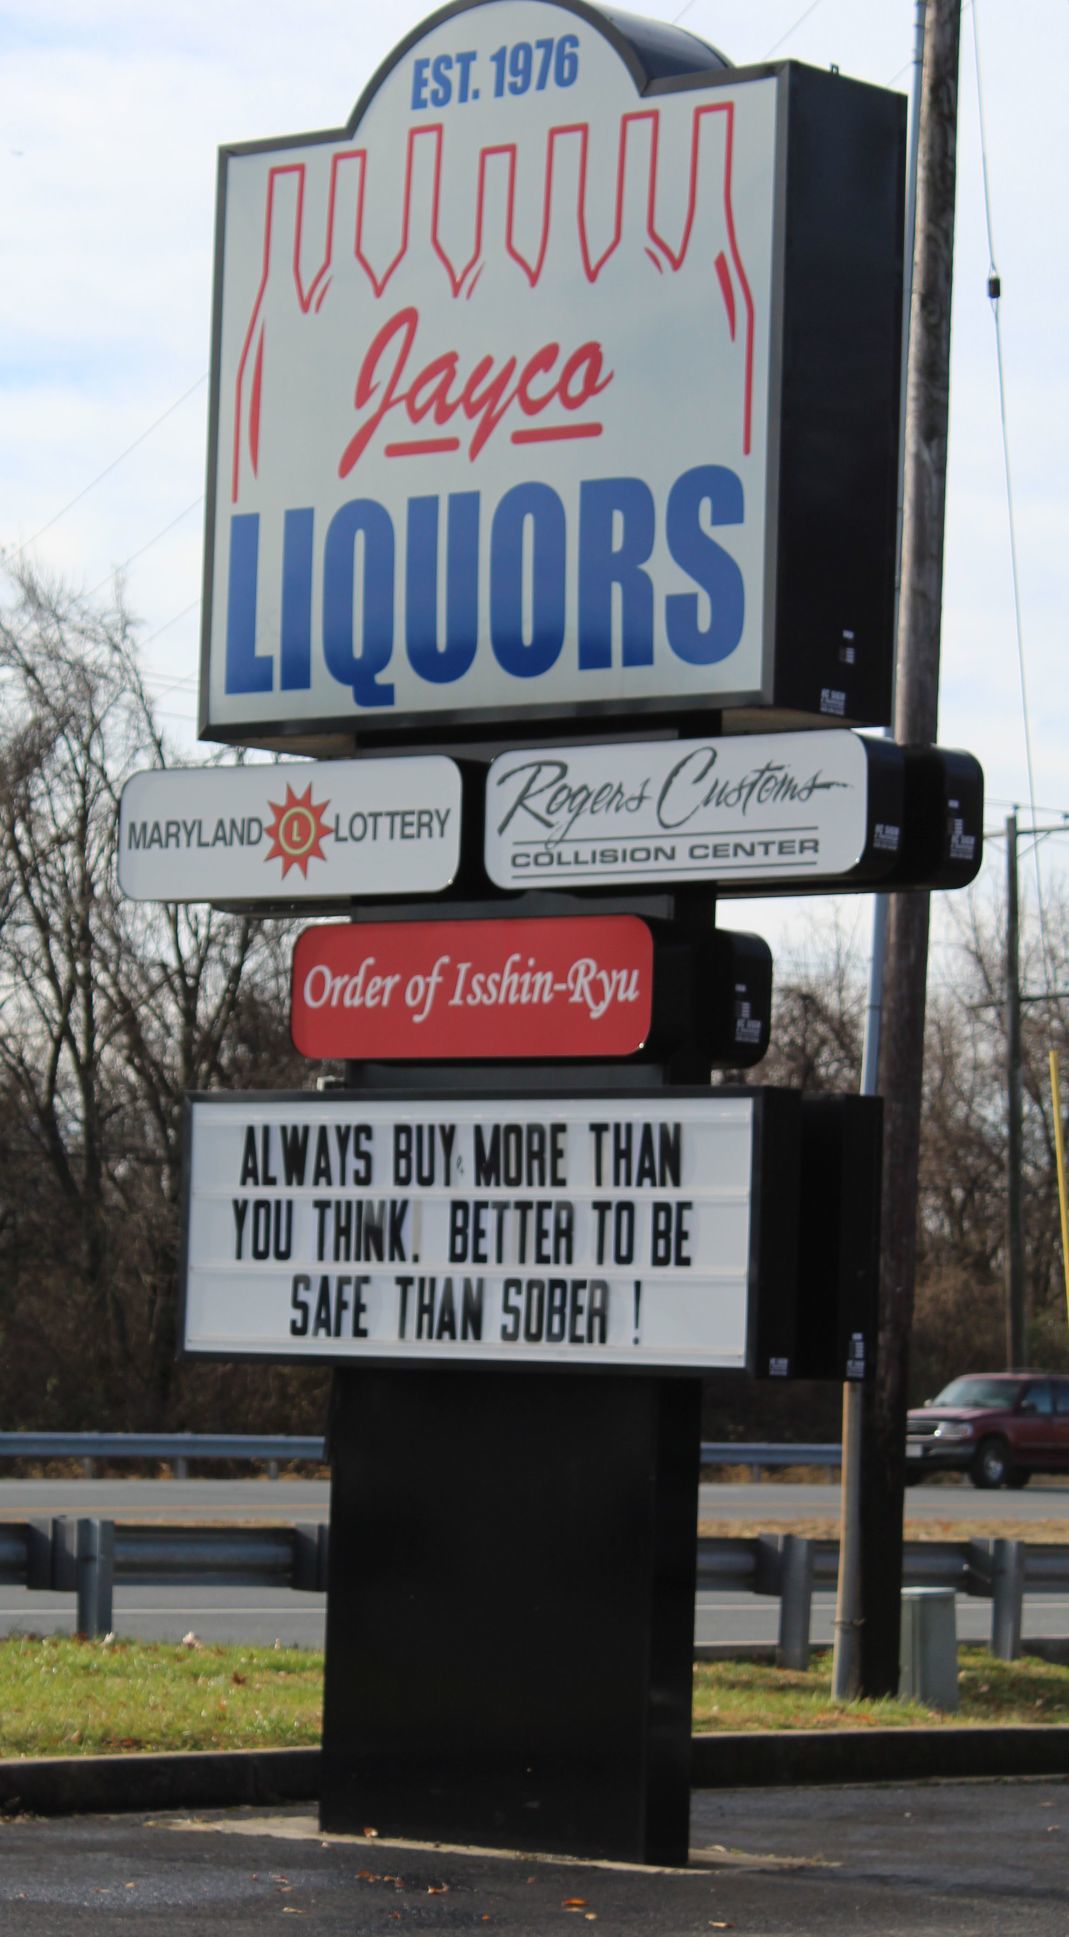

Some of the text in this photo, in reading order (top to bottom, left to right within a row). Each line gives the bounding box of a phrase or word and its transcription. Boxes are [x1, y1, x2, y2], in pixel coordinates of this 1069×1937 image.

[410, 34, 579, 110] EST. 1976
[337, 306, 614, 479] Jayco
[224, 464, 745, 707] LIQUORS
[128, 817, 263, 850] MARYLAND
[334, 809, 450, 842] LOTTERY
[497, 746, 854, 849] Rogers Customs
[511, 839, 820, 868] COLLISION CENTER
[303, 953, 639, 1023] Order of Isshin-Ryu
[240, 1123, 681, 1187] ALWAYS BUY MORE THAN
[232, 1199, 692, 1267] YOU THINK. BETTER TO BE
[290, 1274, 642, 1345] SAFE THAN SOBER !
